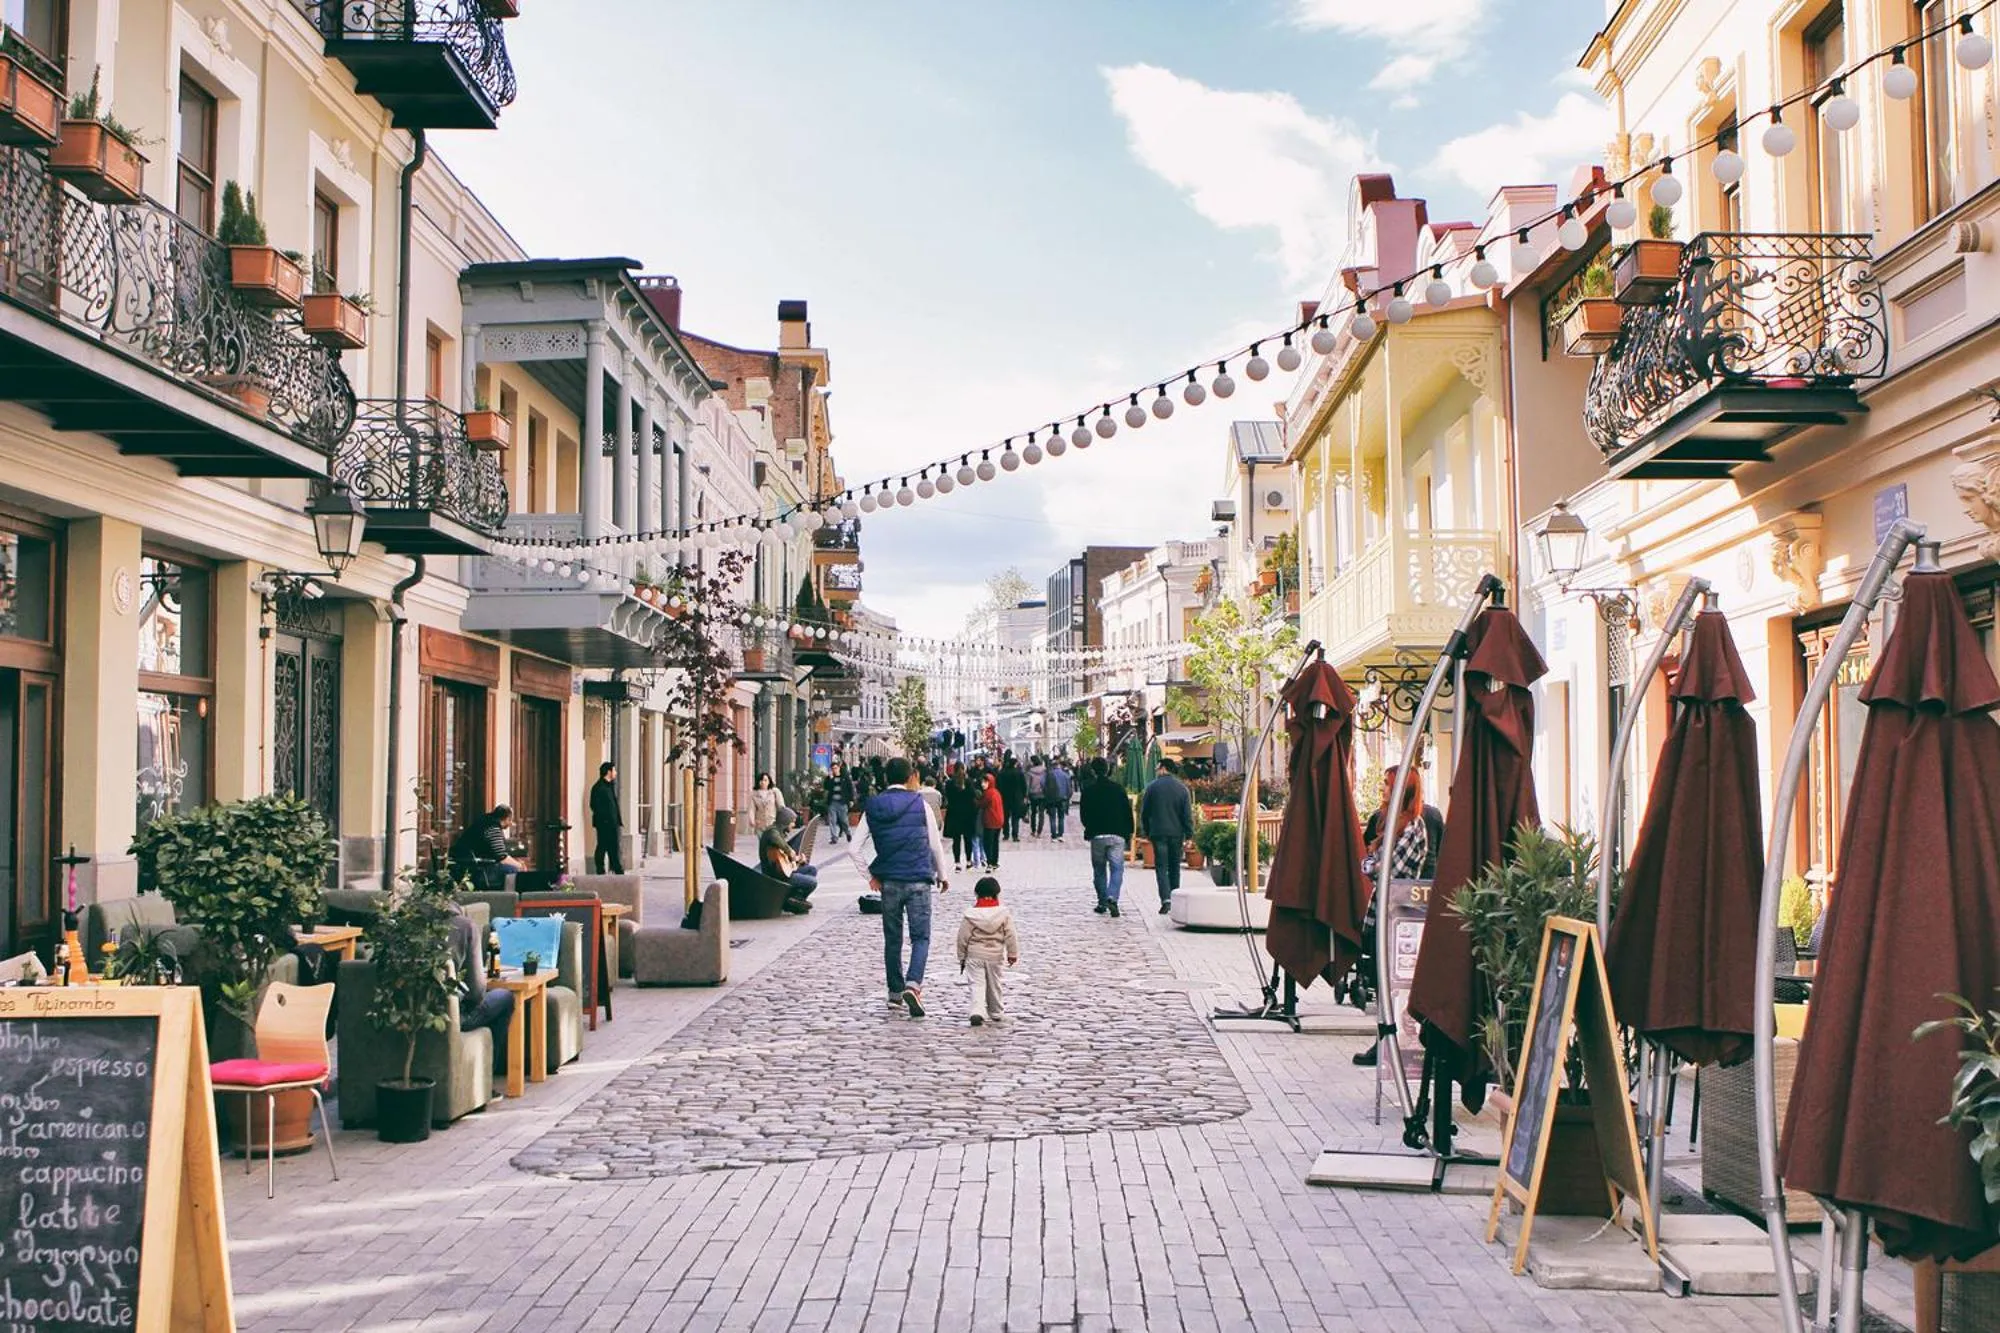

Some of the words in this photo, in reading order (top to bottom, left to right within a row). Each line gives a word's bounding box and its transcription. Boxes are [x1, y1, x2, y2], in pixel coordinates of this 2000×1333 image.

[51, 1057, 147, 1087] espresso
[28, 1121, 146, 1139] americano
[20, 1164, 143, 1196] cappucino
[18, 1192, 121, 1230] latte
